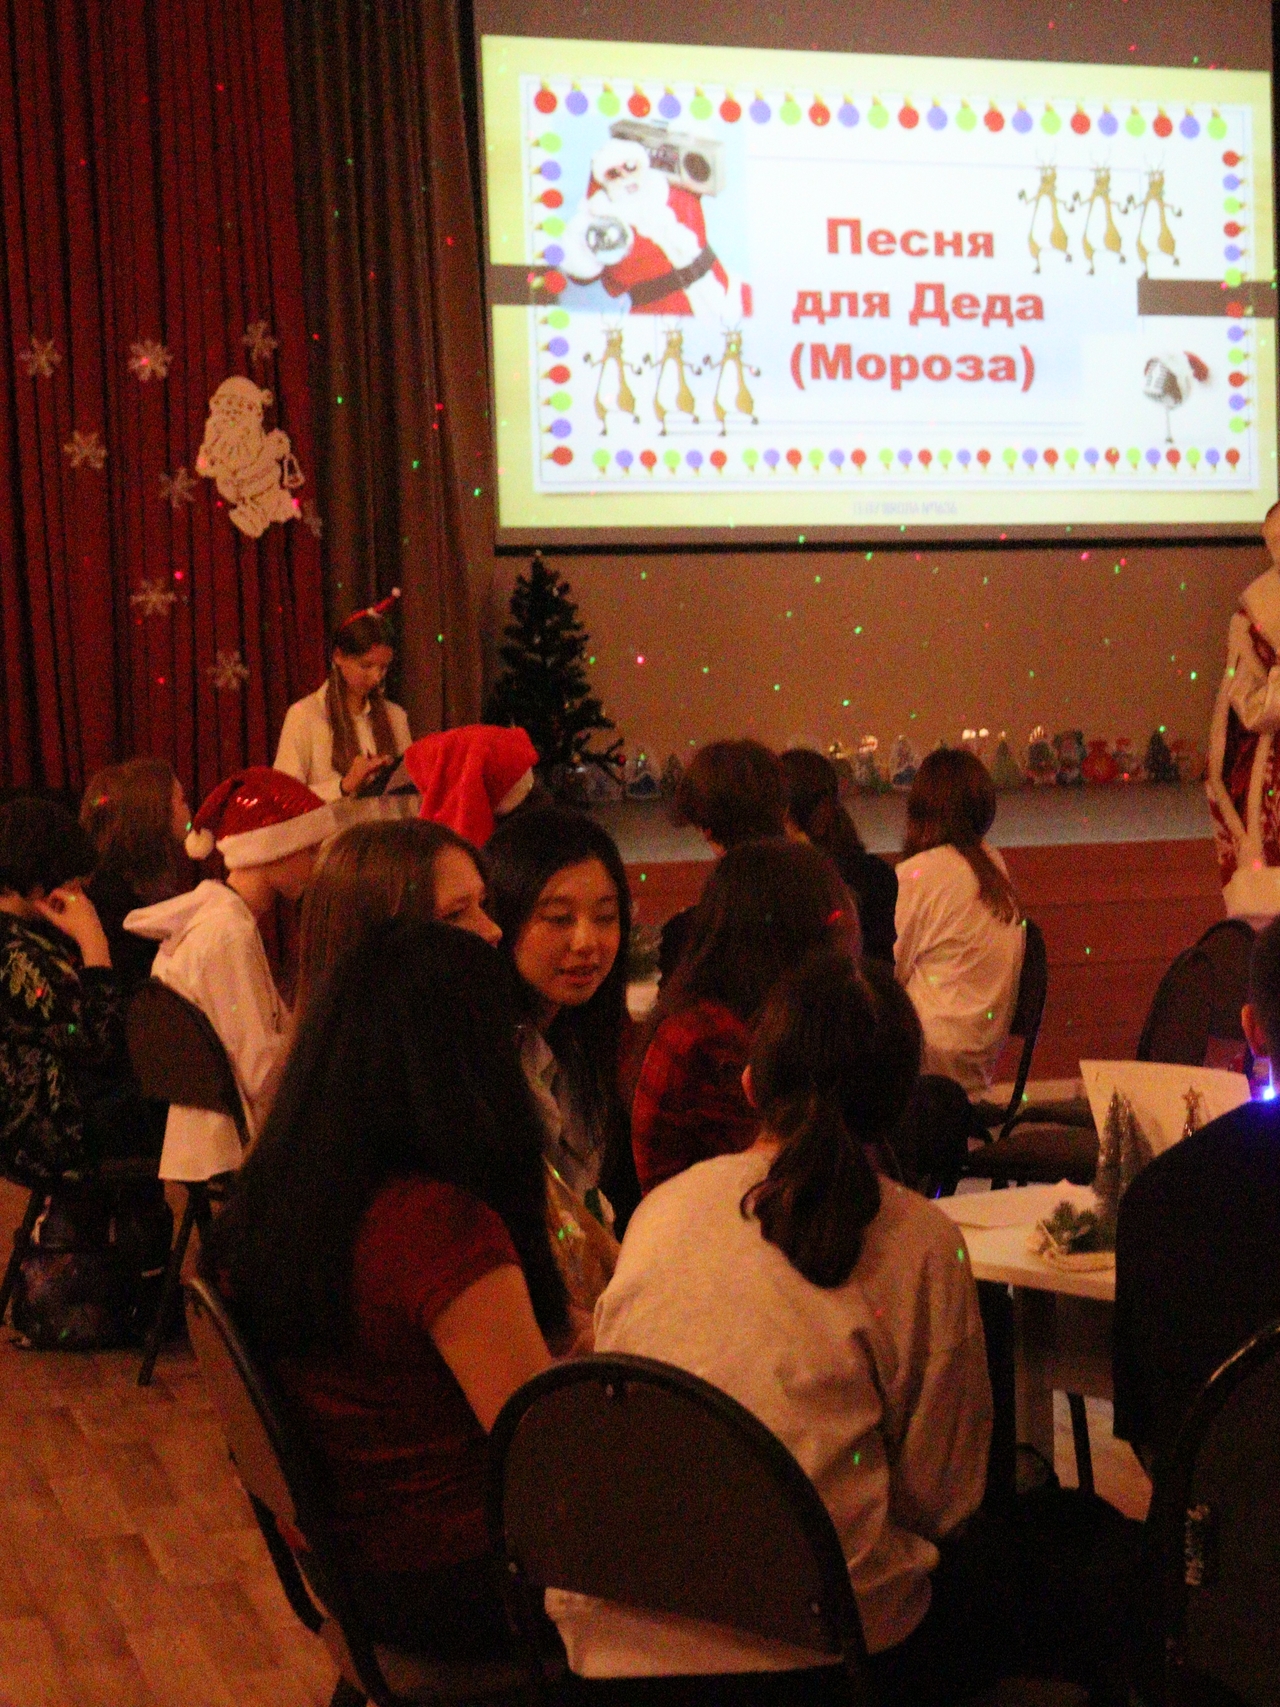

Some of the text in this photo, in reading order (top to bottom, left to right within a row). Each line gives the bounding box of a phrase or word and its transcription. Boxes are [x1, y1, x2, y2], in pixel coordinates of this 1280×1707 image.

[826, 217, 994, 258] Песня
[792, 282, 1044, 327] для Деда
[790, 342, 1035, 393] (Мороза)
